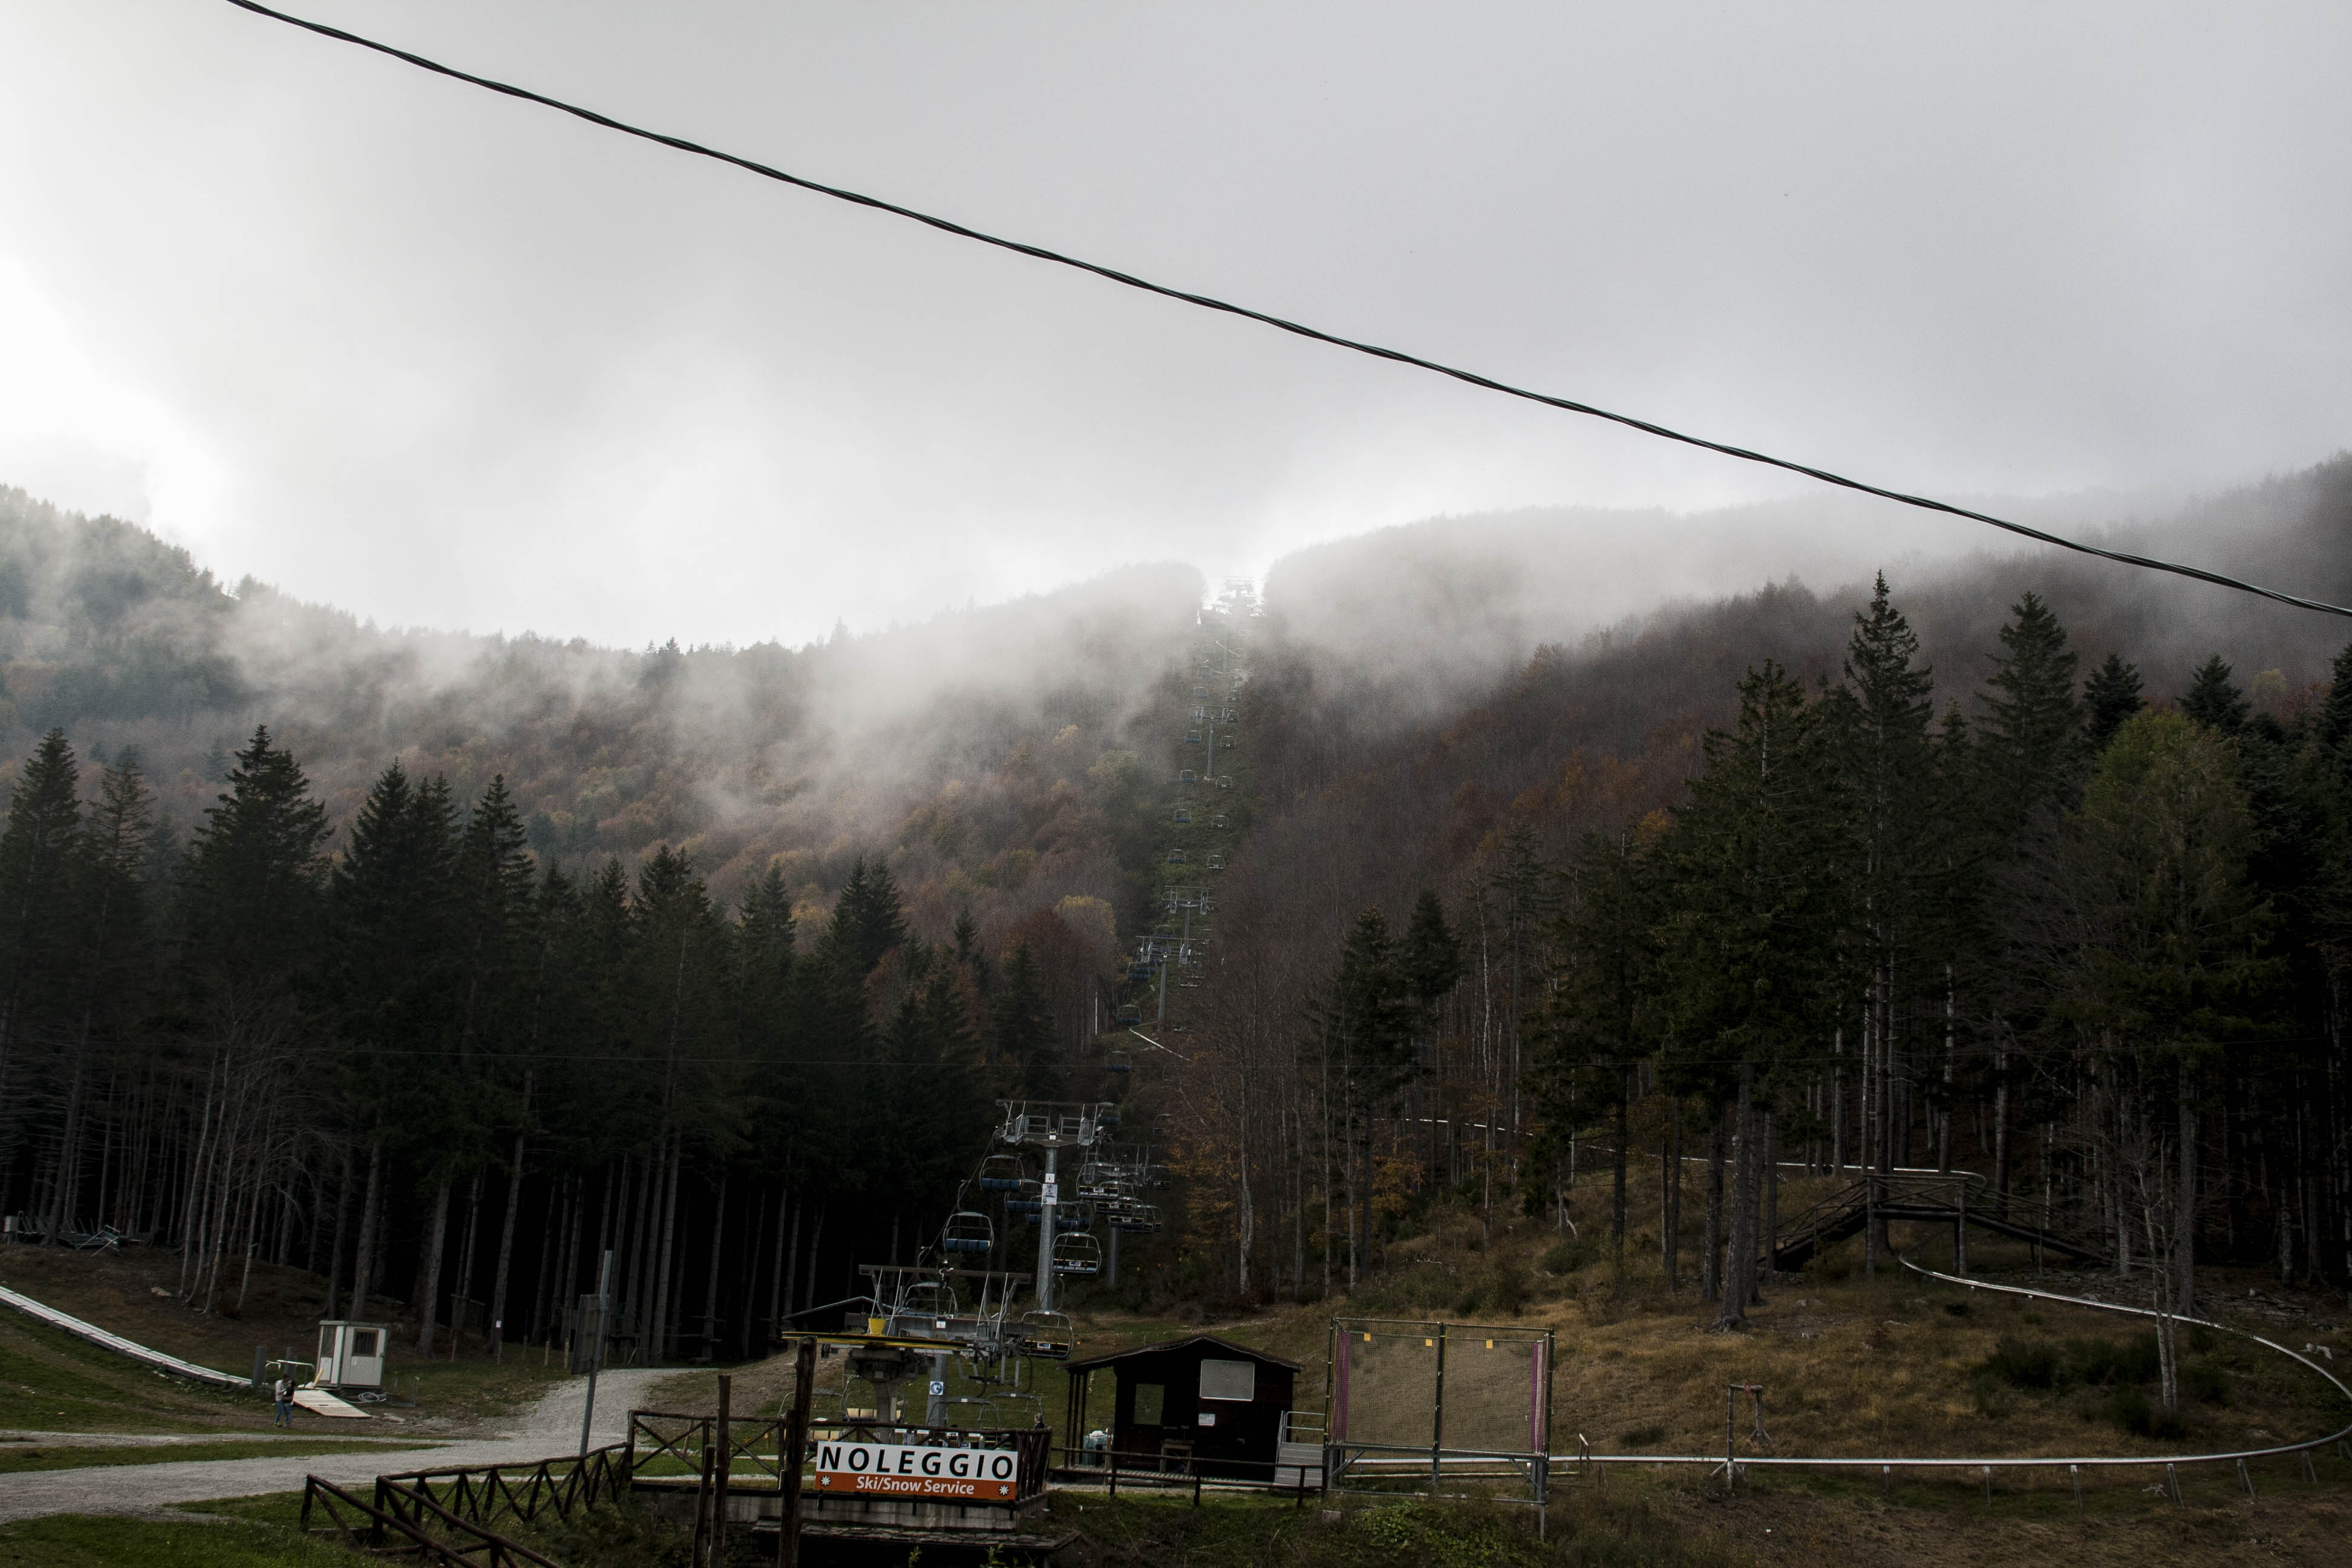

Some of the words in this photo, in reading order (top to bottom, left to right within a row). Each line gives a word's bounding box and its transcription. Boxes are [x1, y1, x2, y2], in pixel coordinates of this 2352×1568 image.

[820, 1446, 1013, 1479] NOLEGGIO
[856, 1475, 922, 1492] Ski/Snow
[923, 1479, 975, 1495] Service
